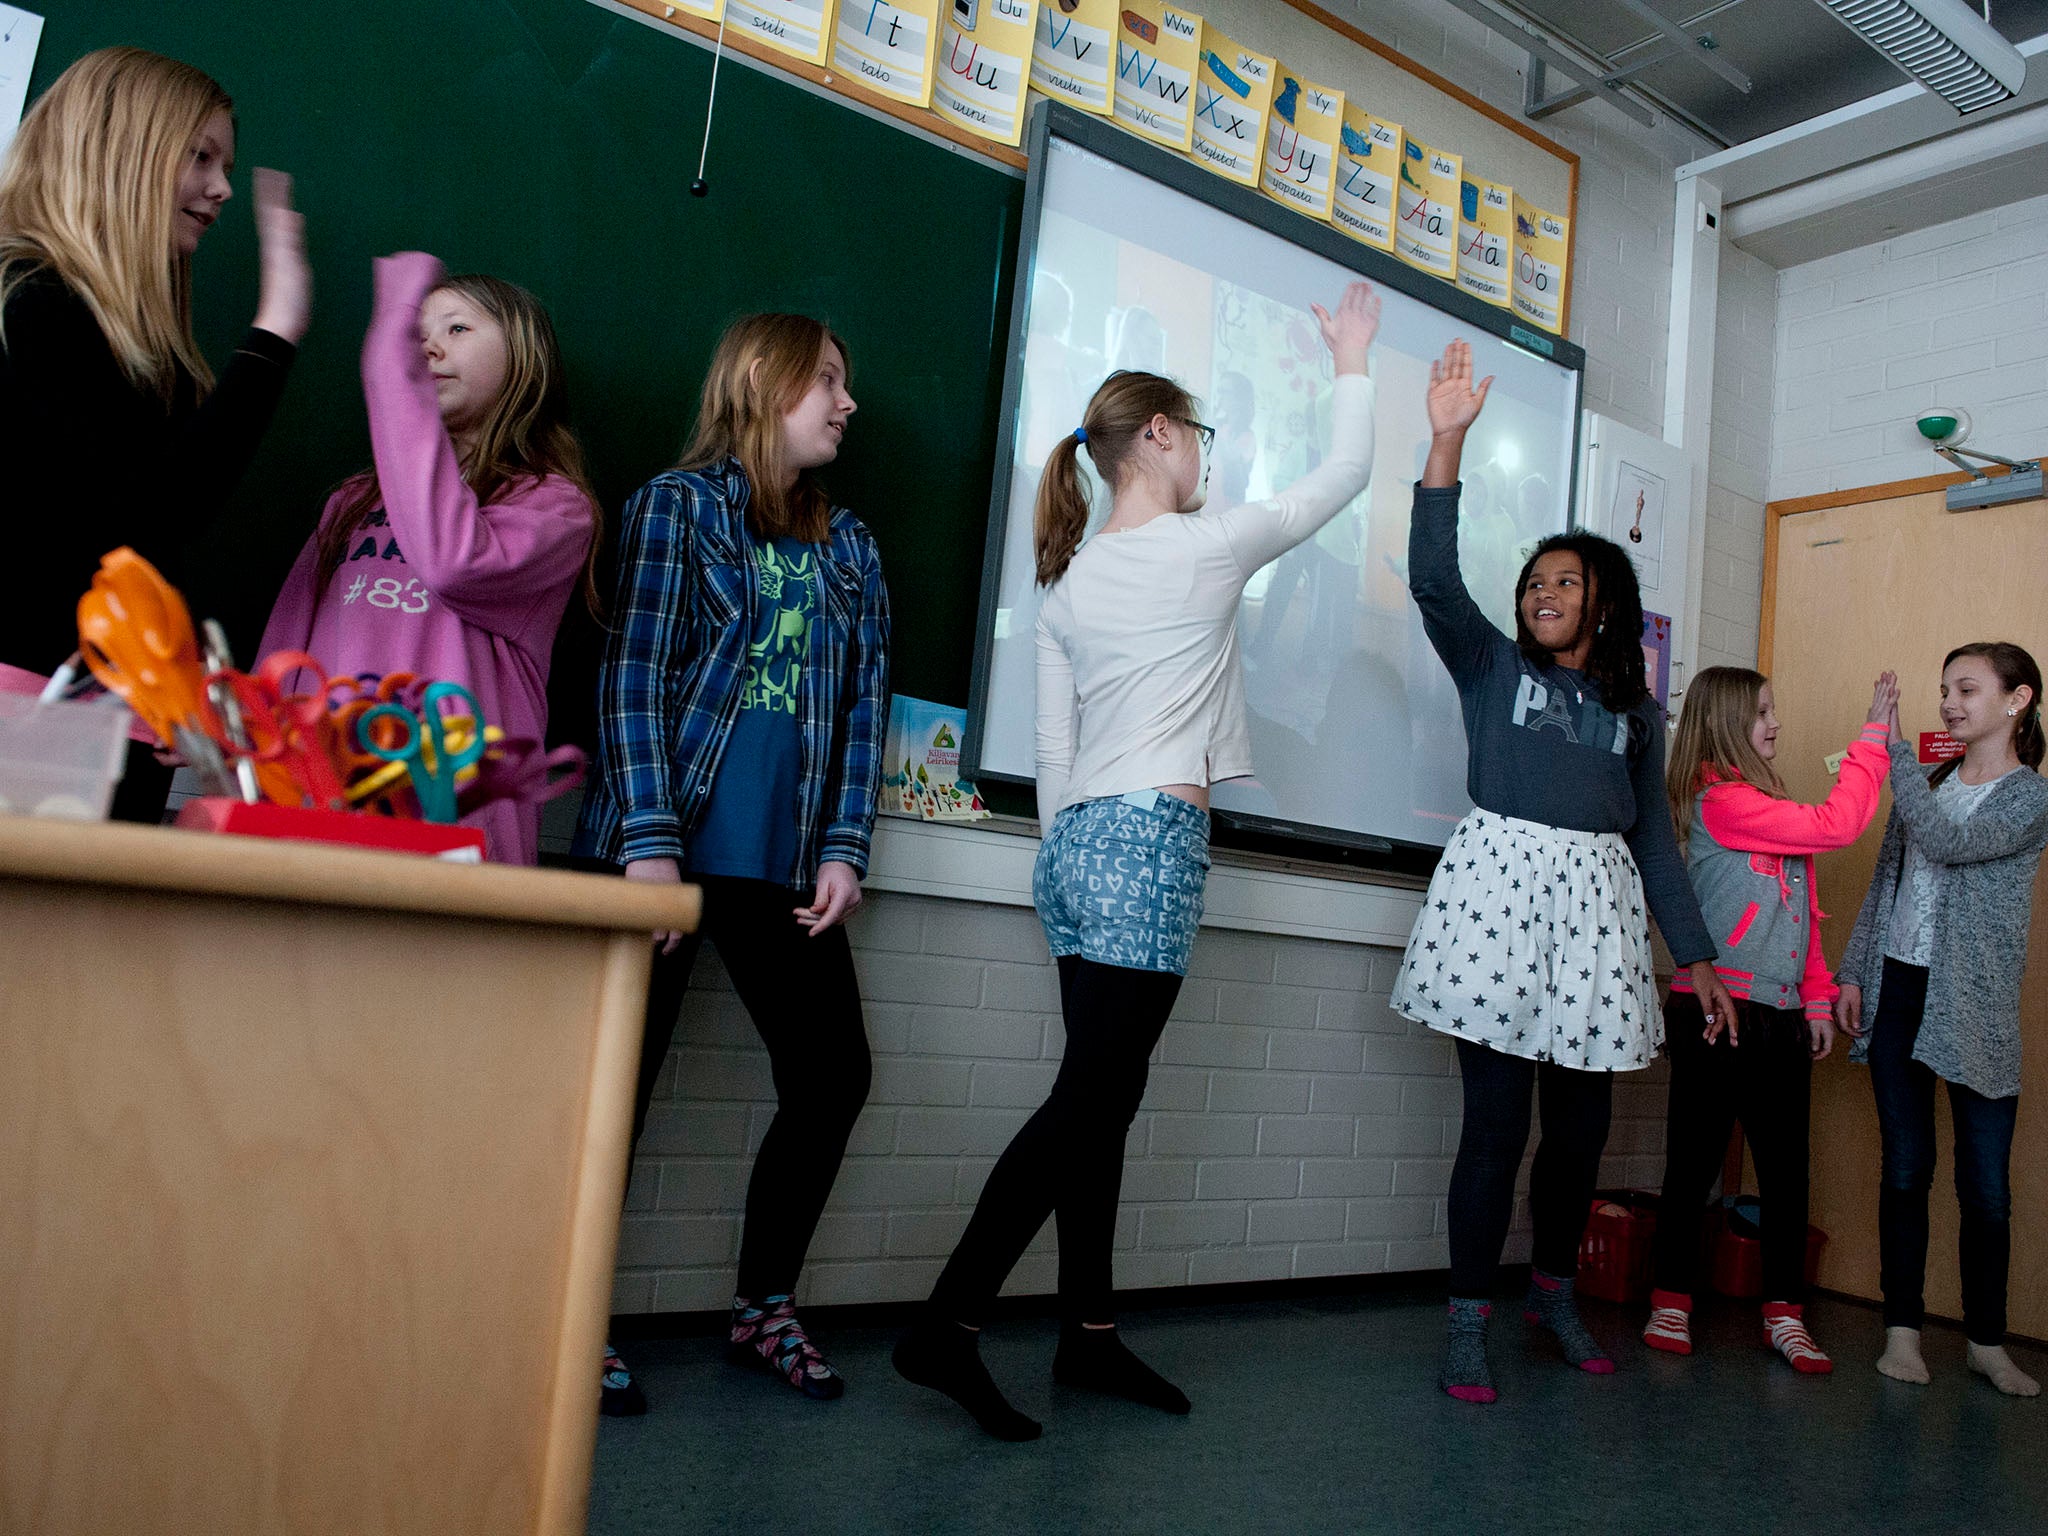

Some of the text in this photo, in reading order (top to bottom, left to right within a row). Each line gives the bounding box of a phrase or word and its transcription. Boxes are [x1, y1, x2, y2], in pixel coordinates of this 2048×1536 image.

[752, 16, 785, 38] siili
[1164, 10, 1195, 36] Ww
[861, 60, 890, 82] talo
[1242, 55, 1261, 76] Xx
[952, 100, 987, 124] uuni
[1314, 90, 1330, 114] Yy
[1135, 104, 1160, 129] WC
[1374, 123, 1390, 143] Zz
